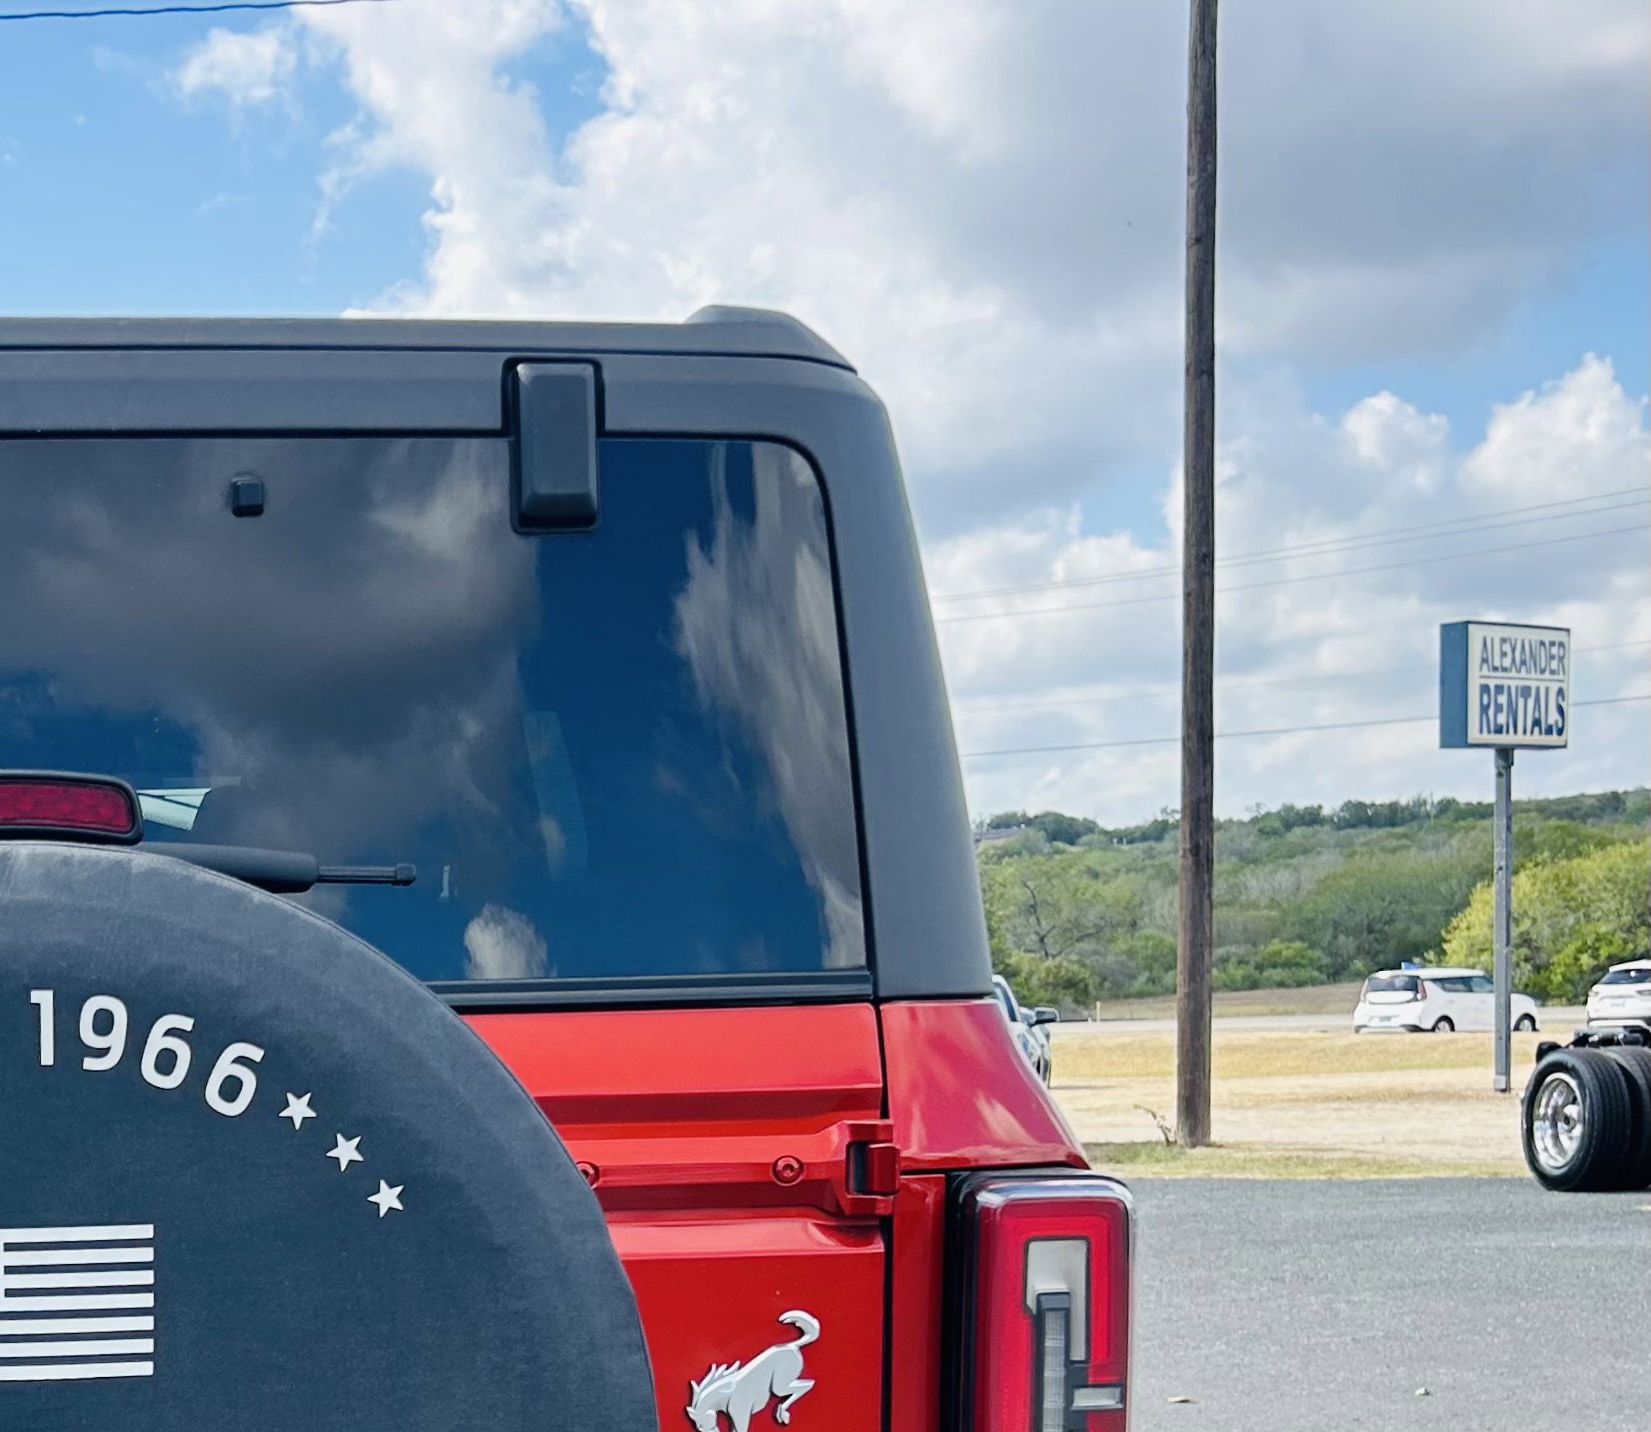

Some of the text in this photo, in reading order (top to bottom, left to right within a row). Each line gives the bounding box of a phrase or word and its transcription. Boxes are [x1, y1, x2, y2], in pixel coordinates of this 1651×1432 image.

[1479, 636, 1566, 676] ALEXANDER
[1479, 683, 1565, 737] RENTALS
[29, 988, 266, 1118] 1966
